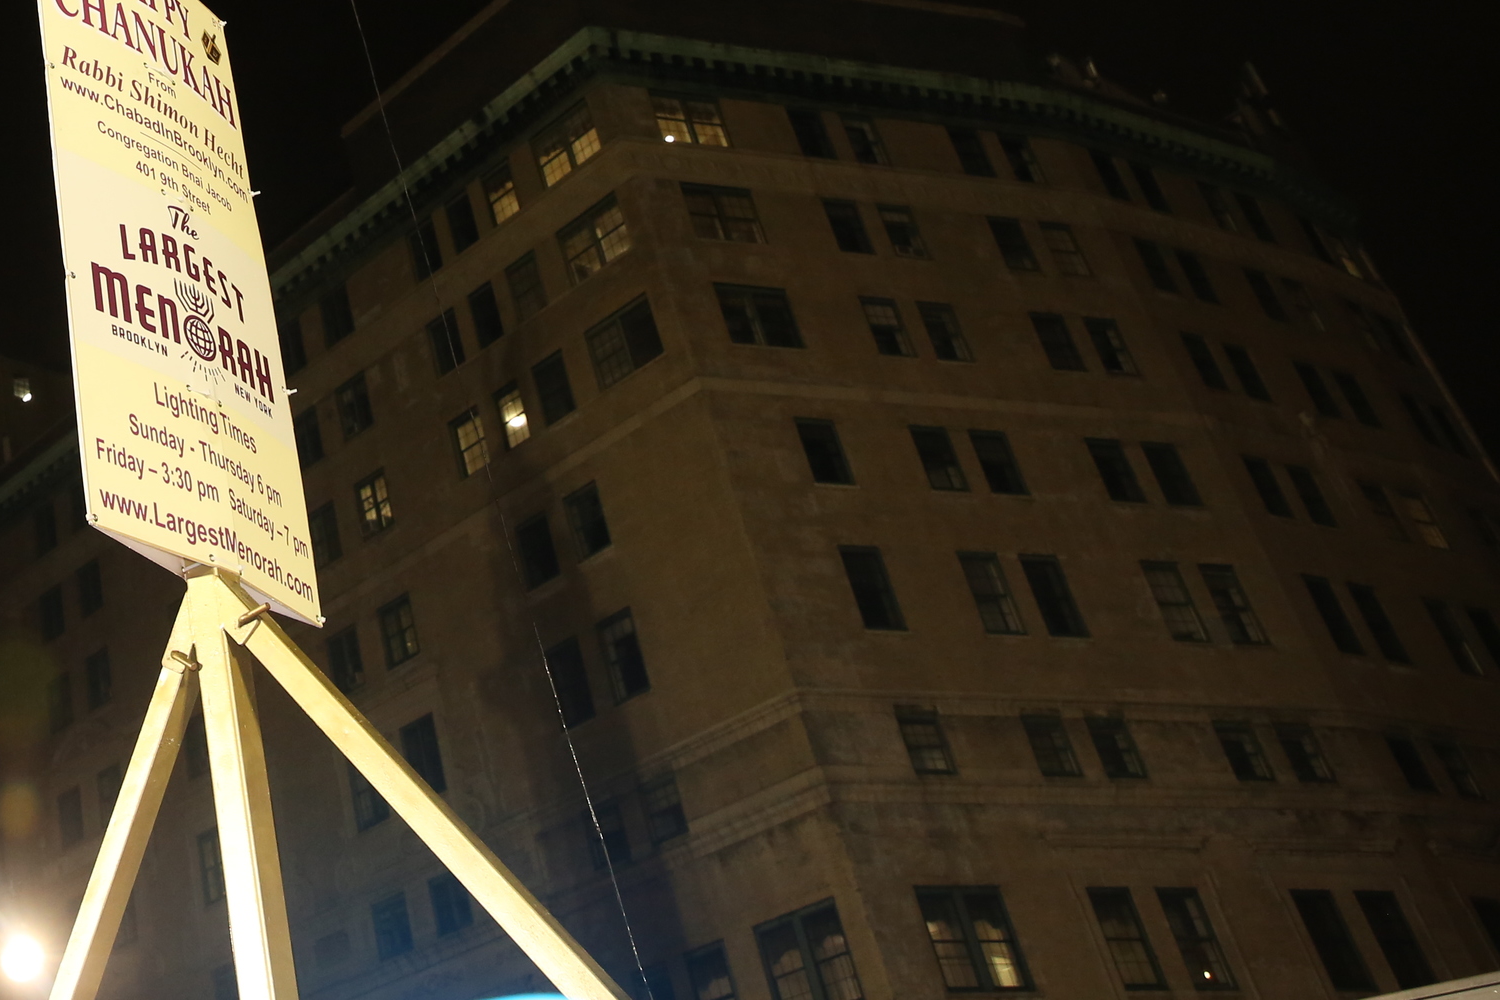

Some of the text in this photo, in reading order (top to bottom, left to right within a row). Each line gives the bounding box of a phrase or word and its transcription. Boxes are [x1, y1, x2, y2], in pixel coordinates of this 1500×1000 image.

[60, 45, 243, 179] Rabbi Shimon Hecht
[148, 72, 176, 99] From
[60, 76, 248, 203] www.ChabadInBrooklyn.com
[97, 120, 232, 212] Congregation Bnai Jacob
[135, 160, 211, 215] 401 9th Street
[167, 205, 199, 240] The
[119, 223, 244, 324] LARGEST
[91, 261, 275, 404] MENORAH
[111, 324, 168, 357] BROOKLYN
[153, 381, 257, 454] Lighting Times
[234, 383, 273, 419] NEW YORK
[96, 437, 144, 480] Friday
[161, 461, 192, 492] 3:30
[197, 480, 220, 503] pm
[228, 487, 275, 541] Saturday
[293, 534, 309, 559] pm
[128, 413, 184, 458] Sunday
[198, 439, 255, 493] Thursday
[257, 474, 264, 495] 6
[266, 485, 282, 508] pm
[99, 488, 315, 603] www.LargestMenorah.com
